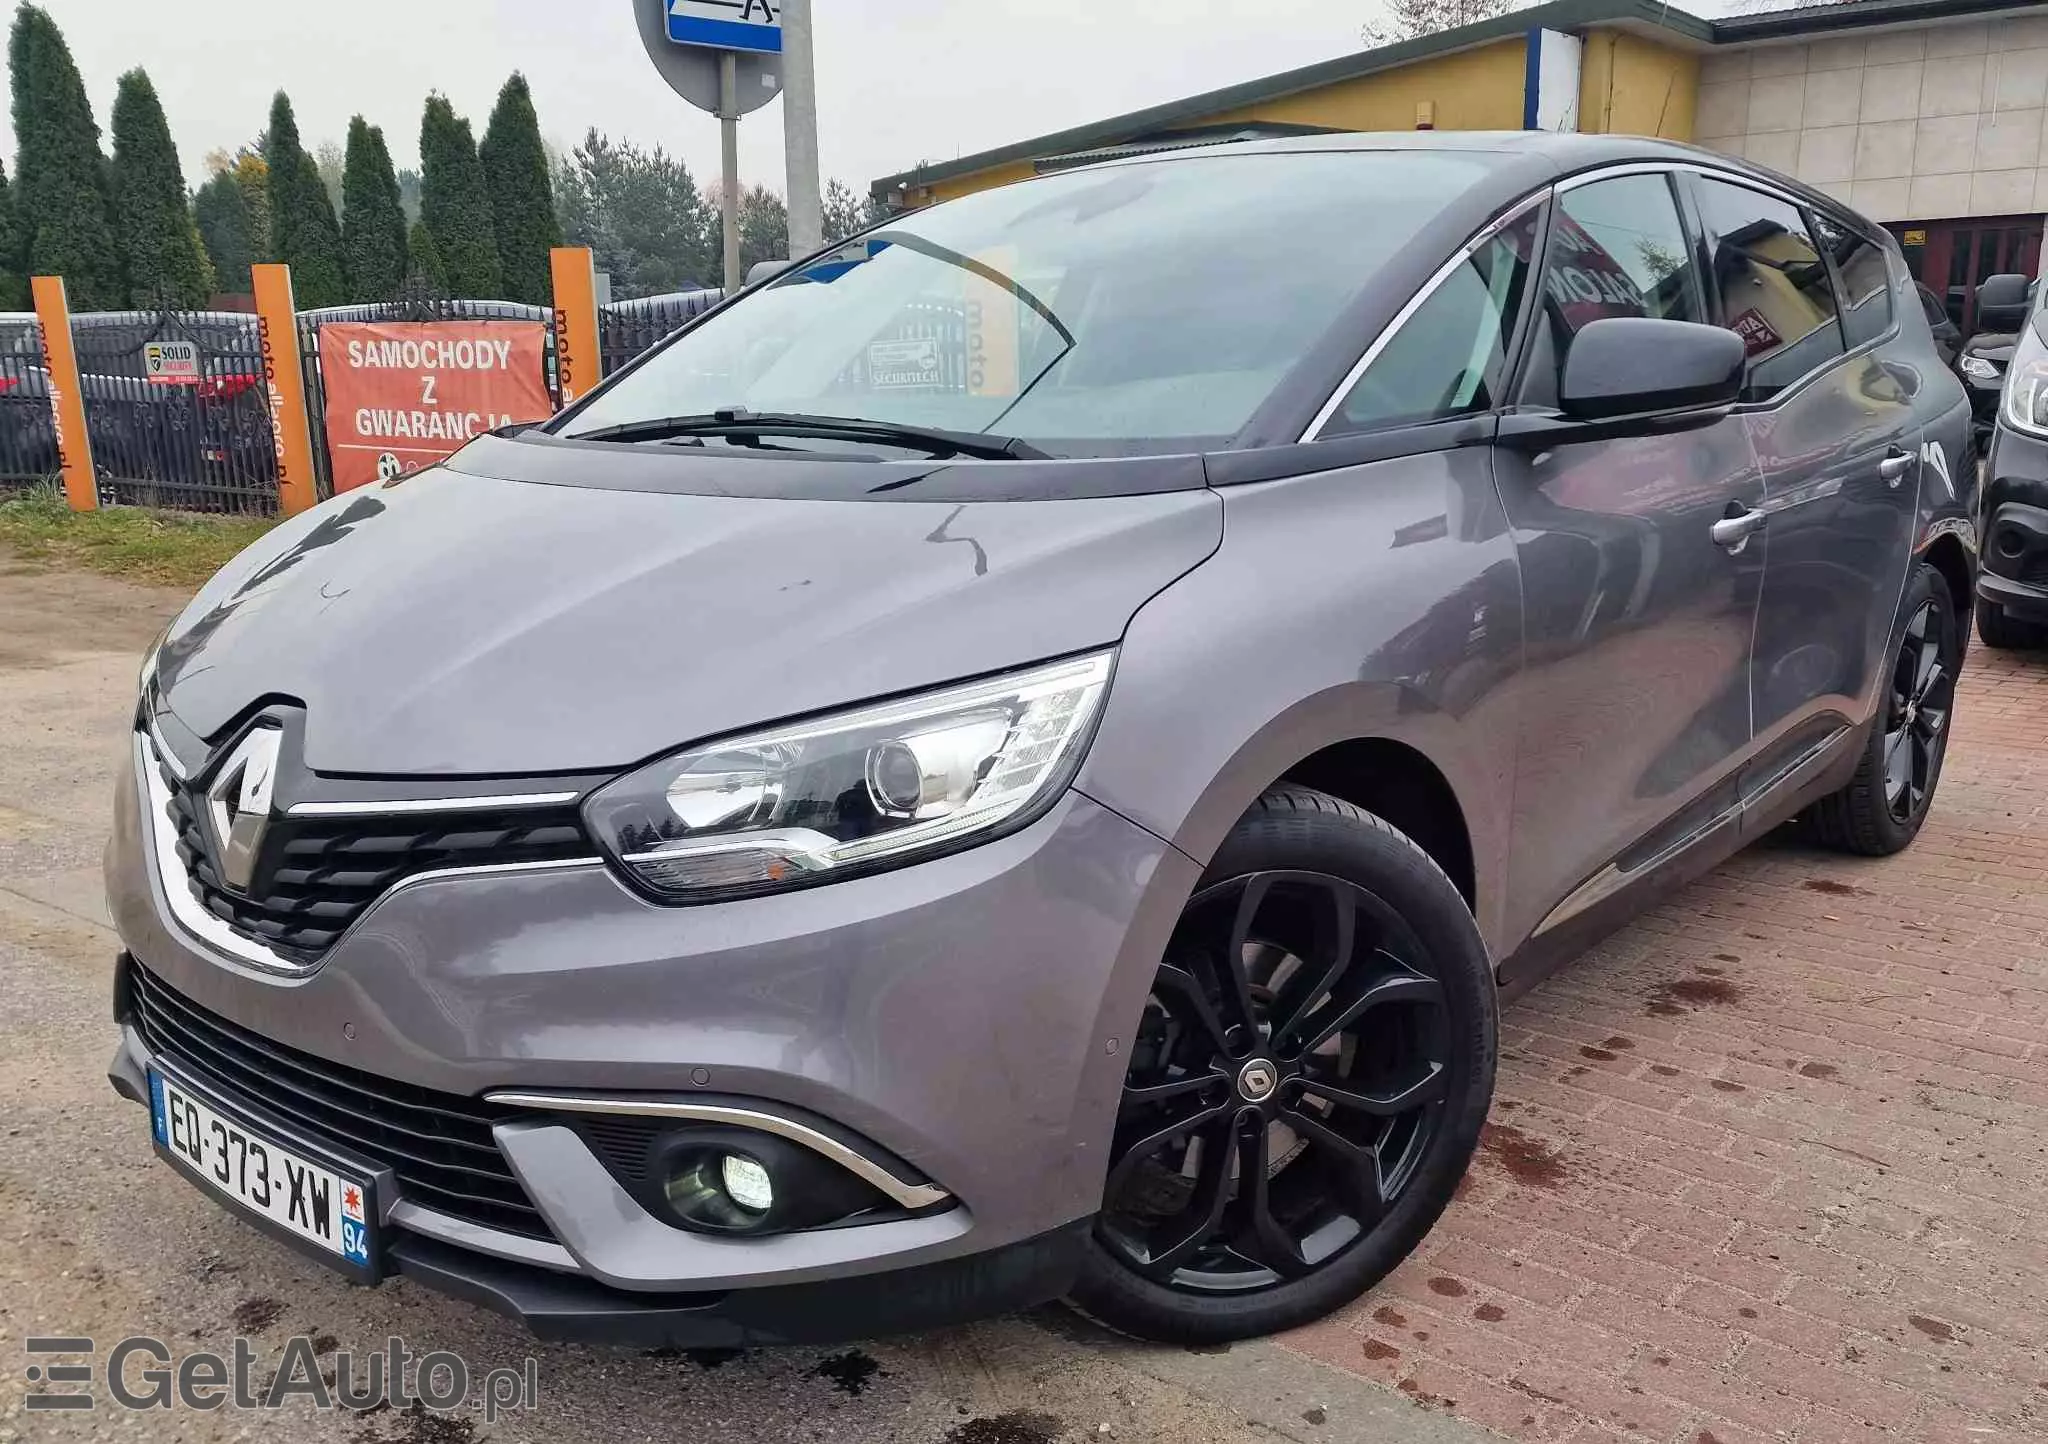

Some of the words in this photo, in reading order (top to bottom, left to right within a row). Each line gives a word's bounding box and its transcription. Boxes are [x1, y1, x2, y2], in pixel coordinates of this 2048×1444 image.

[161, 346, 191, 360] SOLID
[348, 339, 512, 370] SAMOCHODY
[421, 376, 438, 404] Z
[343, 1222, 368, 1259] 94
